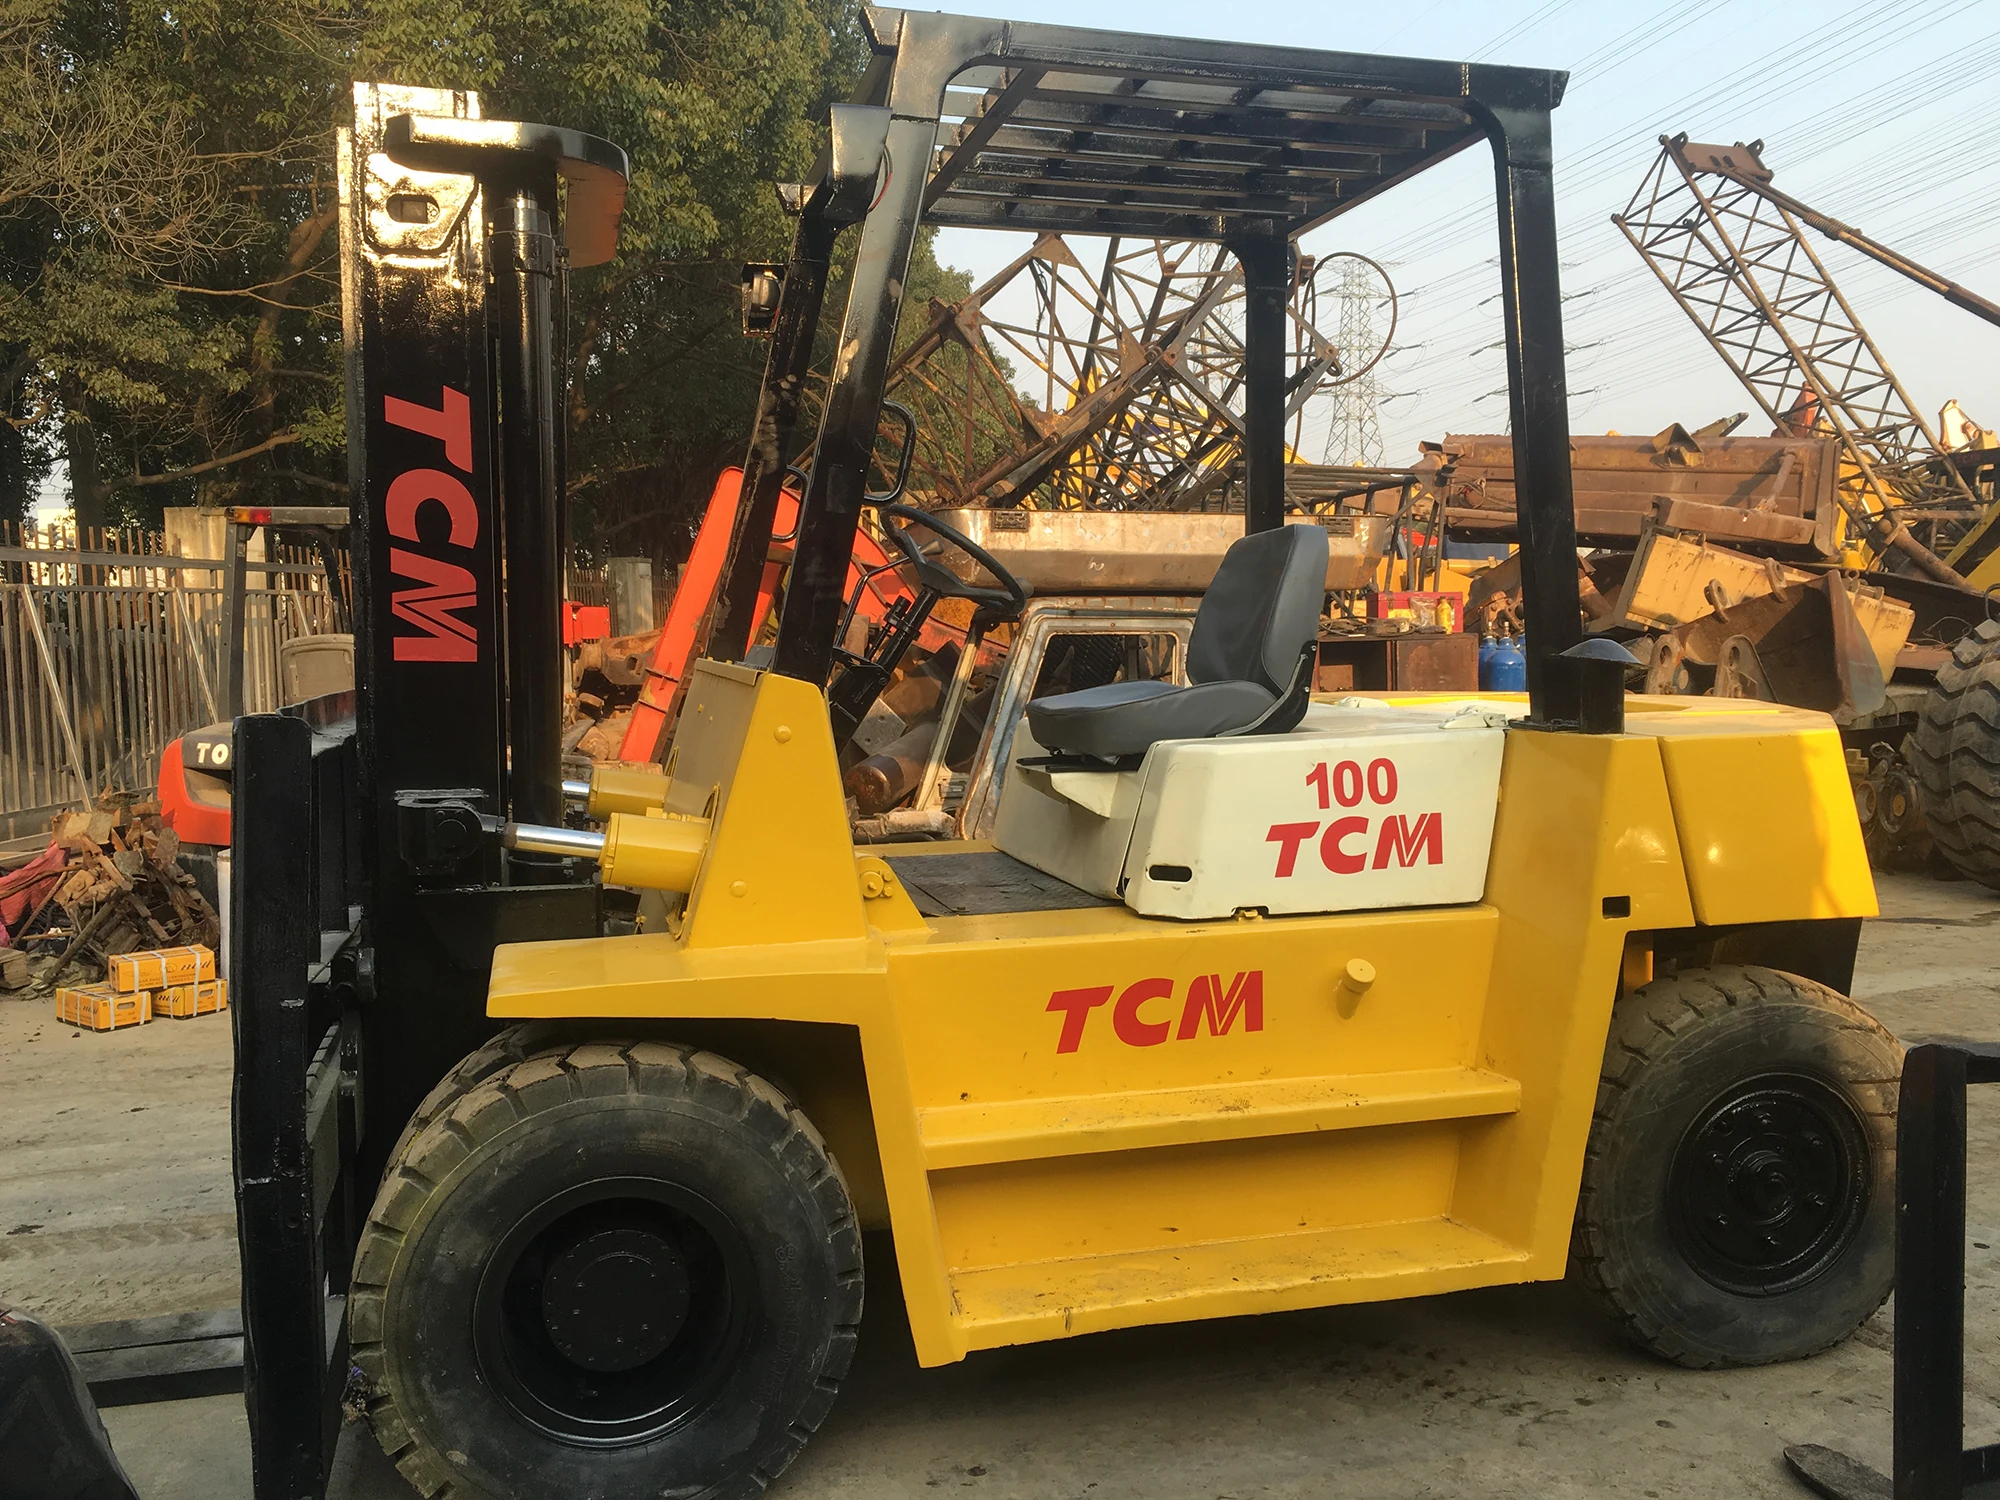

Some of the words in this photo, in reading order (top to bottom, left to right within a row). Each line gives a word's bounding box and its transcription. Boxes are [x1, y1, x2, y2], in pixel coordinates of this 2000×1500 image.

[384, 386, 479, 662] TCM
[1306, 758, 1398, 809] 100
[1266, 812, 1443, 878] TCM
[1045, 970, 1264, 1055] TCM
